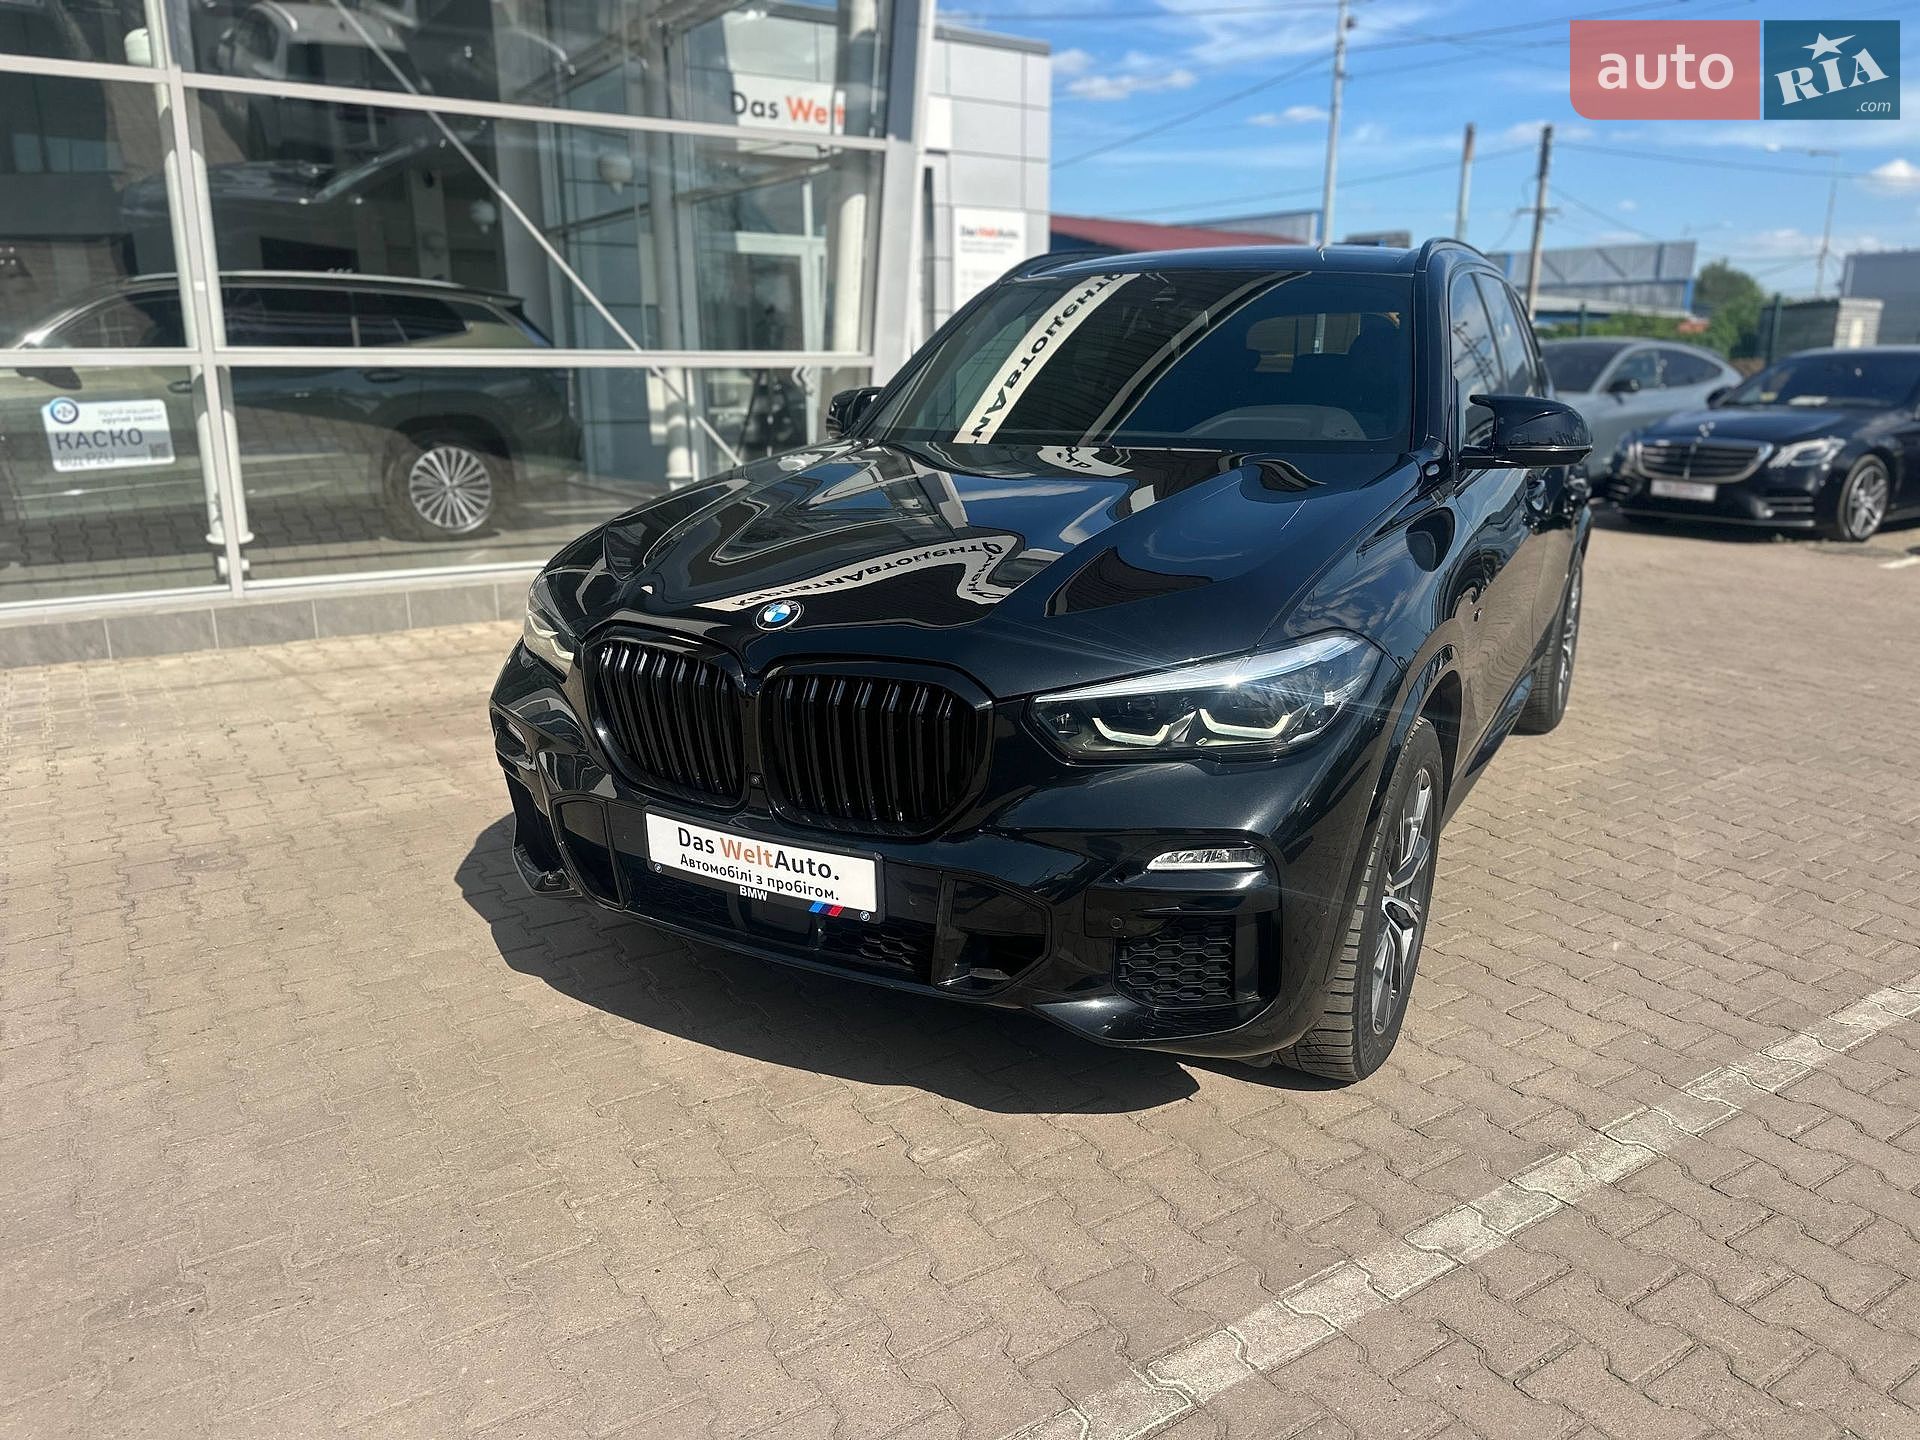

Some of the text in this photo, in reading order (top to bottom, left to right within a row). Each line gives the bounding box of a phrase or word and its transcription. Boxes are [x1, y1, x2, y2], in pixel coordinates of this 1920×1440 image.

[731, 91, 846, 126] Das Wet
[55, 427, 144, 451] КАСКО
[677, 827, 840, 881] Das WeltAuto.
[680, 853, 840, 901] Автомобілі з пробігом.
[739, 886, 768, 901] BMW
